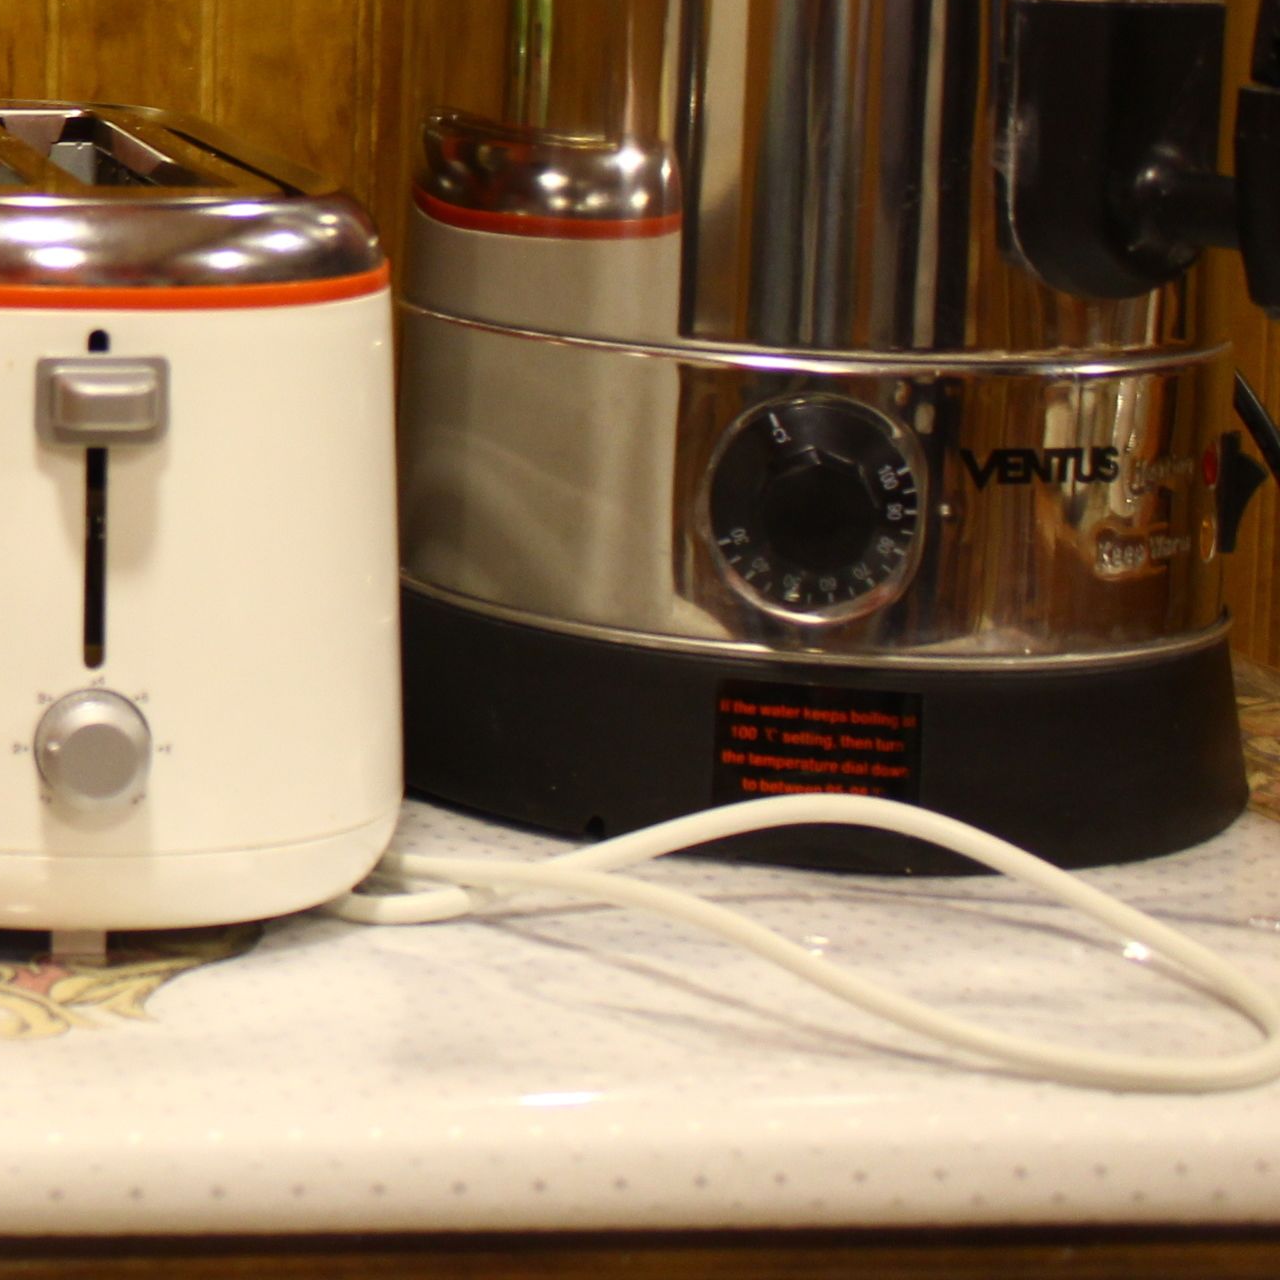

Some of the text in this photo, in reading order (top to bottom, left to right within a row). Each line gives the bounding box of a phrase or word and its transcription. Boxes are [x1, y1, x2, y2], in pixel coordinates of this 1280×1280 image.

[961, 448, 1120, 491] VENTUS
[733, 700, 757, 716] the
[760, 704, 800, 719] water
[803, 707, 848, 724] keeps
[850, 710, 899, 730] boiling
[840, 735, 873, 750] then
[876, 738, 904, 752] turn
[721, 749, 909, 778] the temperature dial down
[742, 777, 758, 793] to
